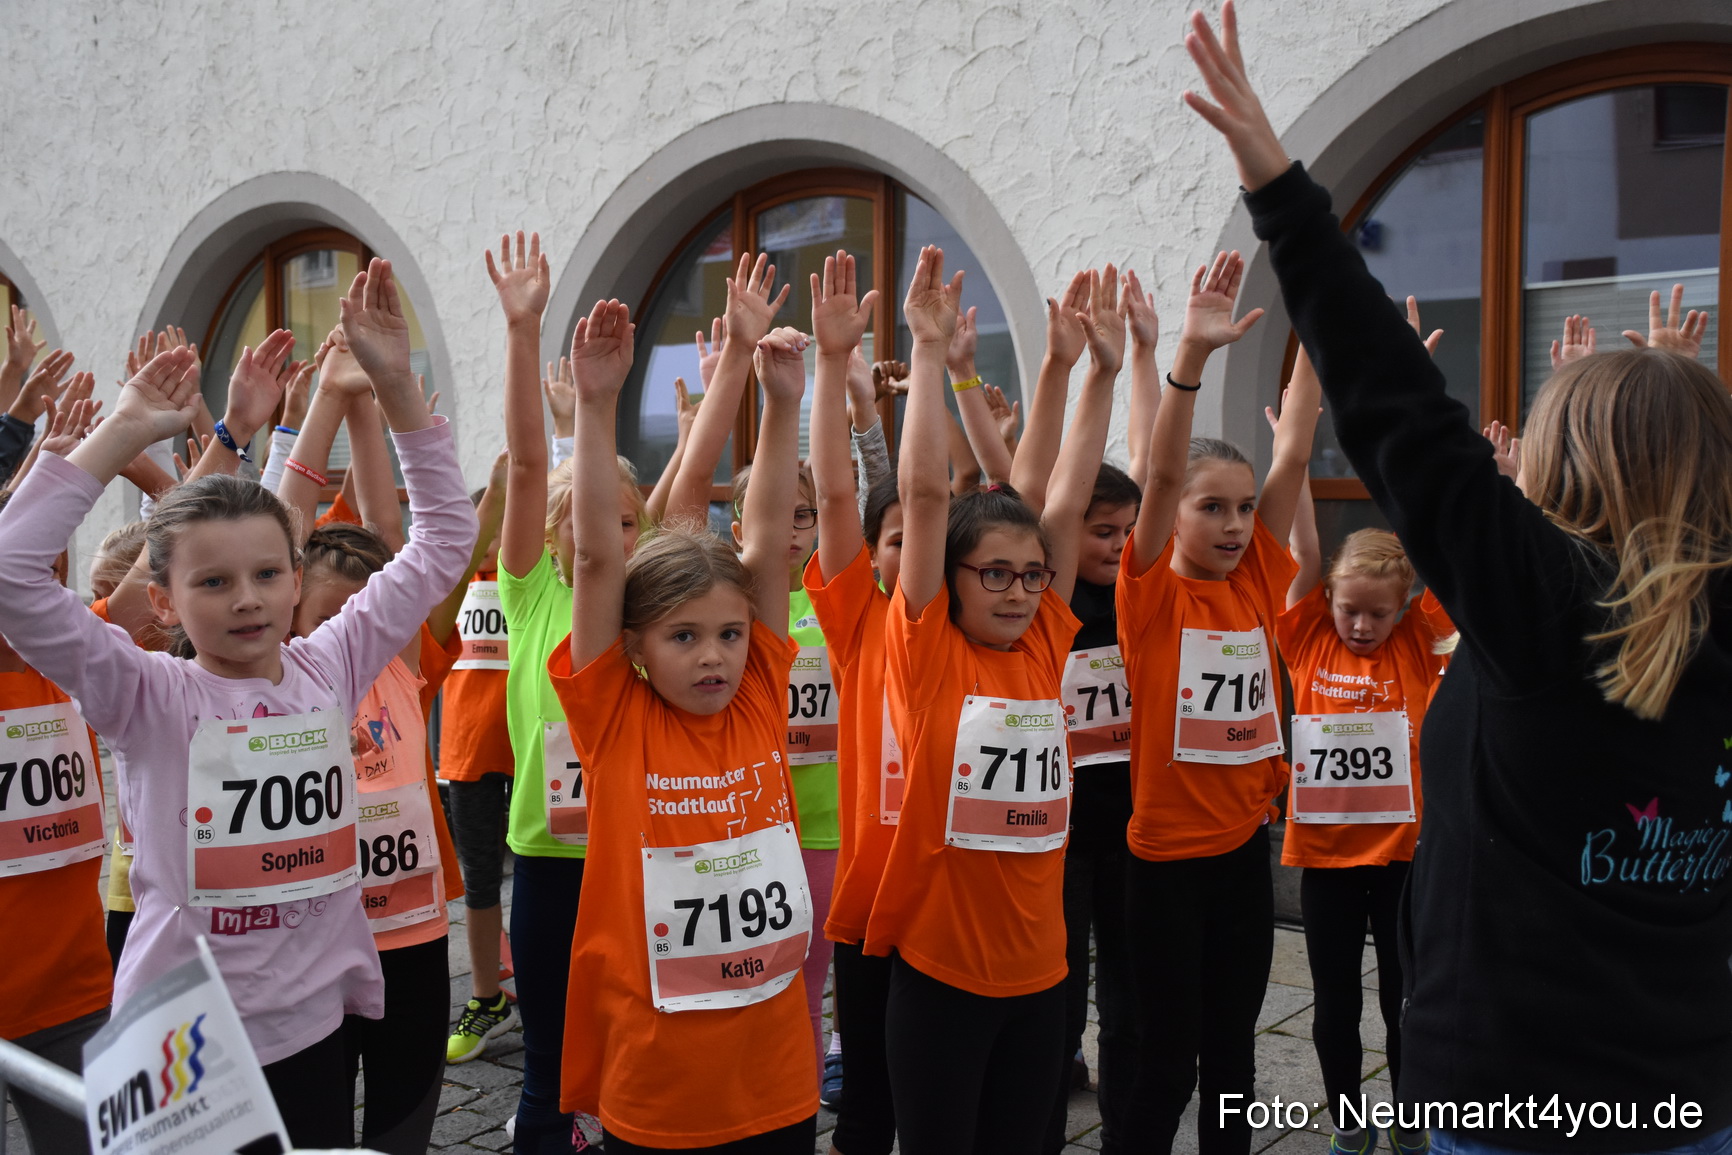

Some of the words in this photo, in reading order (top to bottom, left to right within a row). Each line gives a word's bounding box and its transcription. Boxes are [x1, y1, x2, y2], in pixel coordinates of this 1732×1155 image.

[472, 644, 499, 655] Emma
[792, 657, 822, 668] OCK
[1201, 668, 1267, 713] 7164
[1182, 704, 1193, 713] B5
[26, 717, 68, 737] BOCK
[269, 727, 328, 750] BOCK
[788, 731, 811, 746] Lilly
[1333, 722, 1375, 739] BOCK
[980, 745, 1061, 792] 7116
[1309, 746, 1394, 781] 7393
[646, 766, 746, 790] Neumarkter
[957, 781, 969, 791] B5
[222, 765, 343, 835] 7060
[550, 793, 562, 804] B5
[648, 791, 737, 815] Stadtlauf
[1006, 809, 1048, 826] Emilia
[23, 819, 80, 844] Victoria
[196, 829, 212, 841] B5
[1638, 815, 1713, 854] Magic
[261, 845, 325, 873] Sophia
[712, 848, 761, 872] BOCK
[363, 894, 388, 909] isa
[218, 906, 275, 934] mia
[673, 880, 793, 947] 7193
[656, 943, 669, 953] B5
[720, 956, 765, 979] Katja
[134, 1096, 212, 1145] neumarkt
